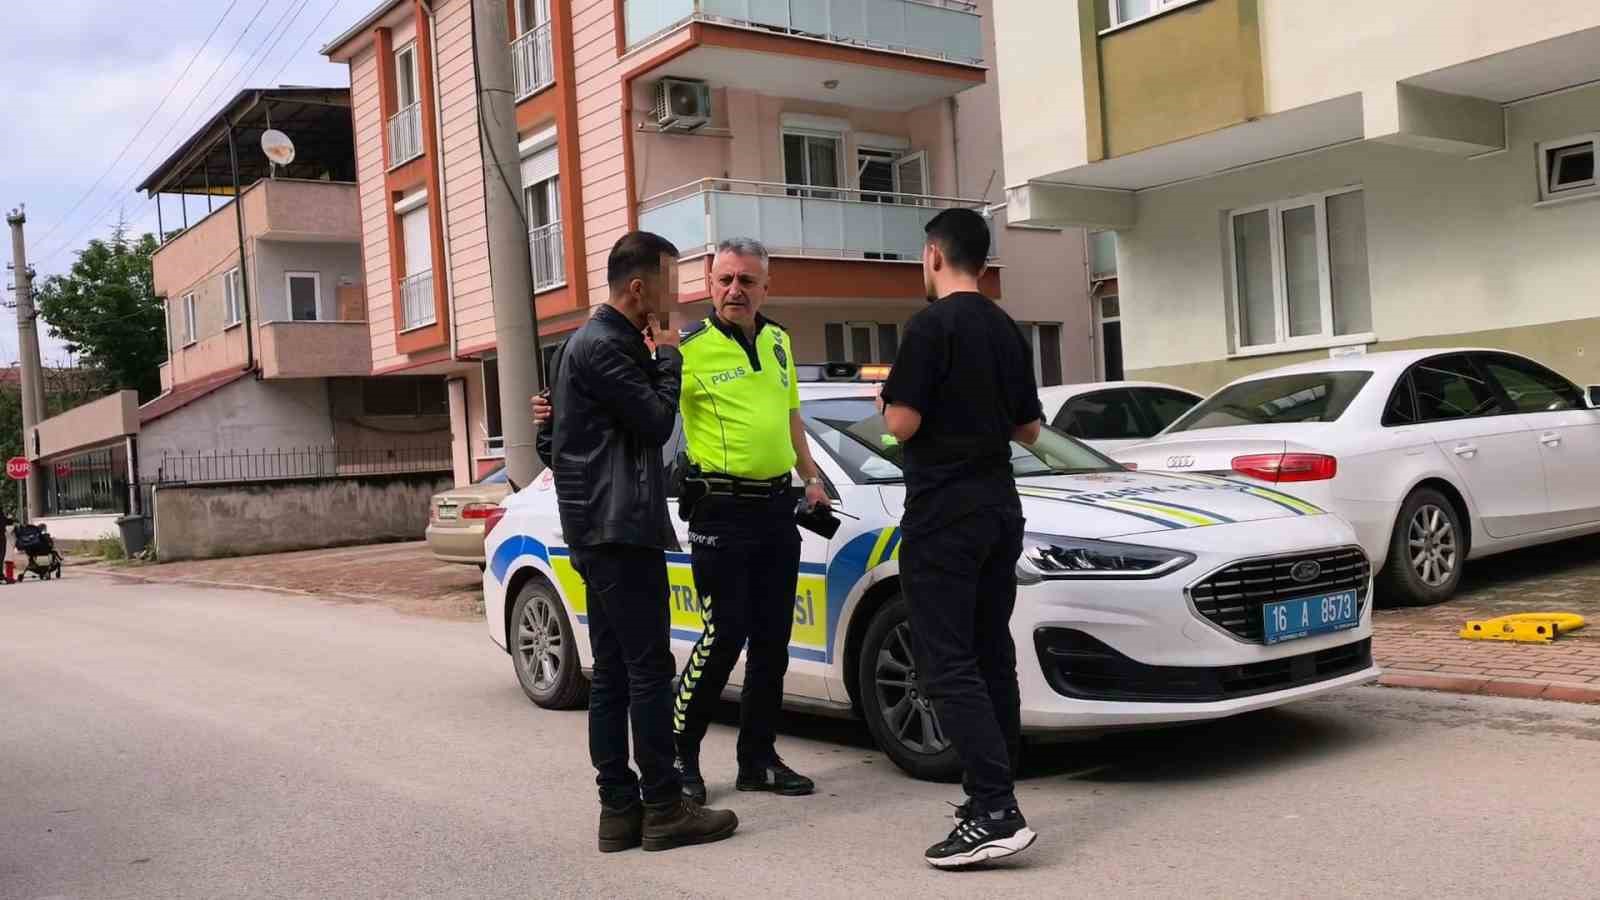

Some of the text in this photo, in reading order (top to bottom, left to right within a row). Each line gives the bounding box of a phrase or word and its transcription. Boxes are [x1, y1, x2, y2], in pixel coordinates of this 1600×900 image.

[9, 463, 32, 473] DUR
[1273, 594, 1351, 632] 16 A 8573
